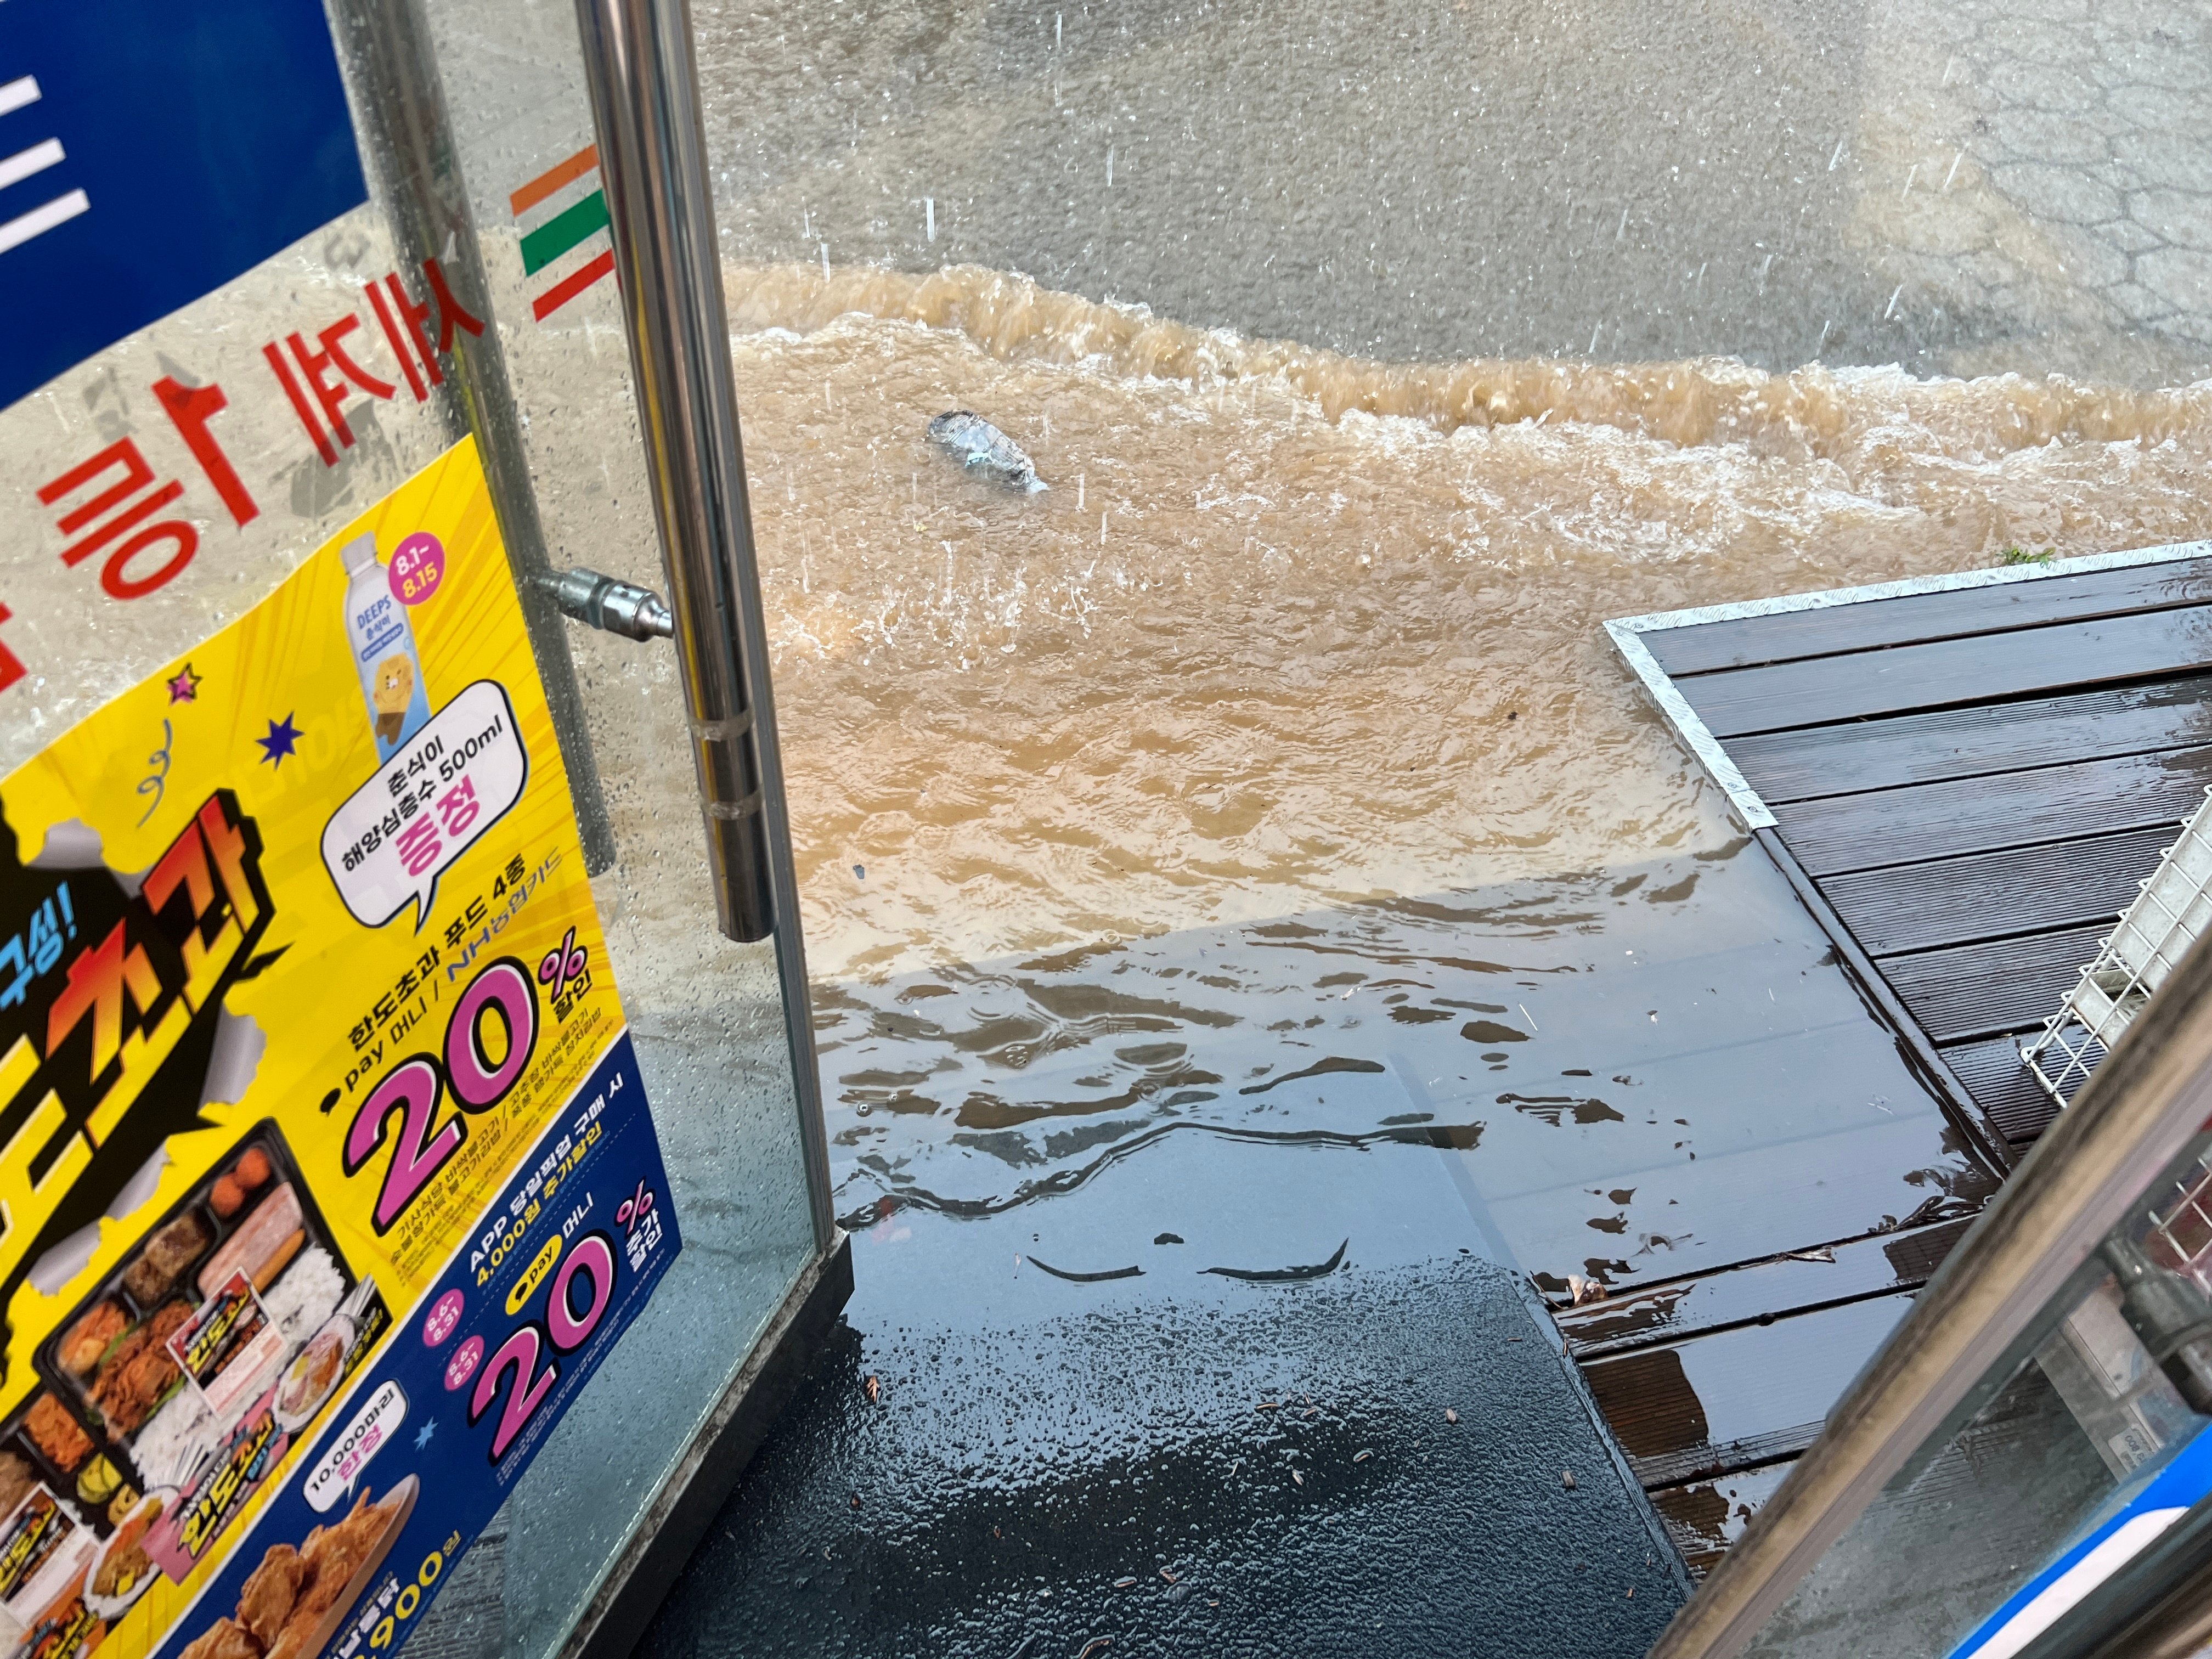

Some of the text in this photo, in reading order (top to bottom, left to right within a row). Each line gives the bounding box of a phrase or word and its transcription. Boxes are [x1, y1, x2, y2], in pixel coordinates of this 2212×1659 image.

[357, 594, 391, 629] DEEPS
[402, 561, 438, 598] 8.15
[342, 780, 437, 871] 해양심층수
[439, 714, 503, 782] 500ml
[387, 734, 444, 798] 춘식이
[396, 774, 480, 877] 증정
[345, 1041, 383, 1093] pay
[390, 996, 427, 1045] 머니
[447, 846, 562, 982] NH농협카드
[347, 853, 525, 1052] 한도초과 푸드 4종
[554, 968, 592, 1024] 할인
[397, 1182, 443, 1239] 기사식당
[445, 1116, 499, 1183] 바싹불고기
[510, 1067, 539, 1108] 고추장
[471, 1216, 507, 1273] APP
[510, 1134, 572, 1216] 당일픽업
[574, 1093, 606, 1136] 구매
[610, 1072, 624, 1098] 시
[477, 1198, 541, 1287] 4,000원
[544, 1120, 602, 1199] 추가할인
[626, 1209, 659, 1256] 추가
[529, 1246, 553, 1284] pay
[561, 1192, 594, 1239] 머니
[630, 1223, 663, 1273] 할인
[433, 1306, 459, 1335] 8.31
[453, 1351, 478, 1385] 8.31
[337, 1424, 382, 1481] 한정
